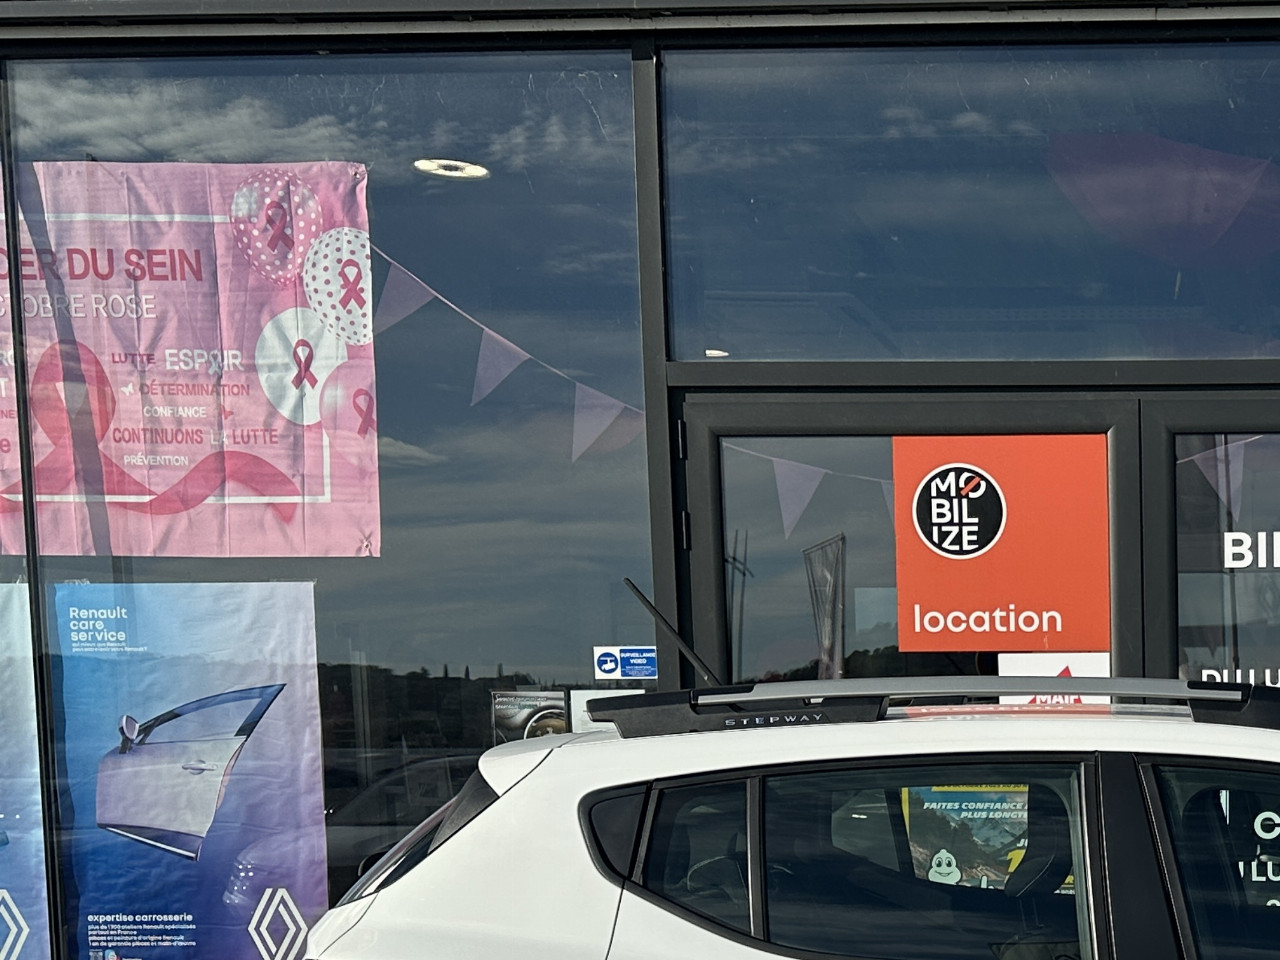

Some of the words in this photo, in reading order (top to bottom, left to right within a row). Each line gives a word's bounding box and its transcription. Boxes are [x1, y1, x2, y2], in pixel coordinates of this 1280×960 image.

[66, 247, 115, 281] DU
[124, 248, 203, 281] SEIN
[92, 294, 158, 319] ROSE
[112, 353, 157, 364] LUTTE
[139, 379, 250, 396] DÉTERMINATION
[143, 406, 207, 418] CONFIANCE
[113, 427, 203, 444] CONTINUONS
[210, 429, 228, 445] LA
[232, 429, 279, 444] LUTTE
[123, 452, 189, 466] PRÉVENTION
[69, 605, 128, 619] Renault
[914, 604, 1062, 633] location
[70, 620, 104, 630] care
[71, 629, 126, 641] service
[725, 713, 822, 726] STEPWAY
[960, 811, 987, 819] PLUS
[87, 913, 134, 923] expertise
[135, 912, 193, 922] carrosserie
